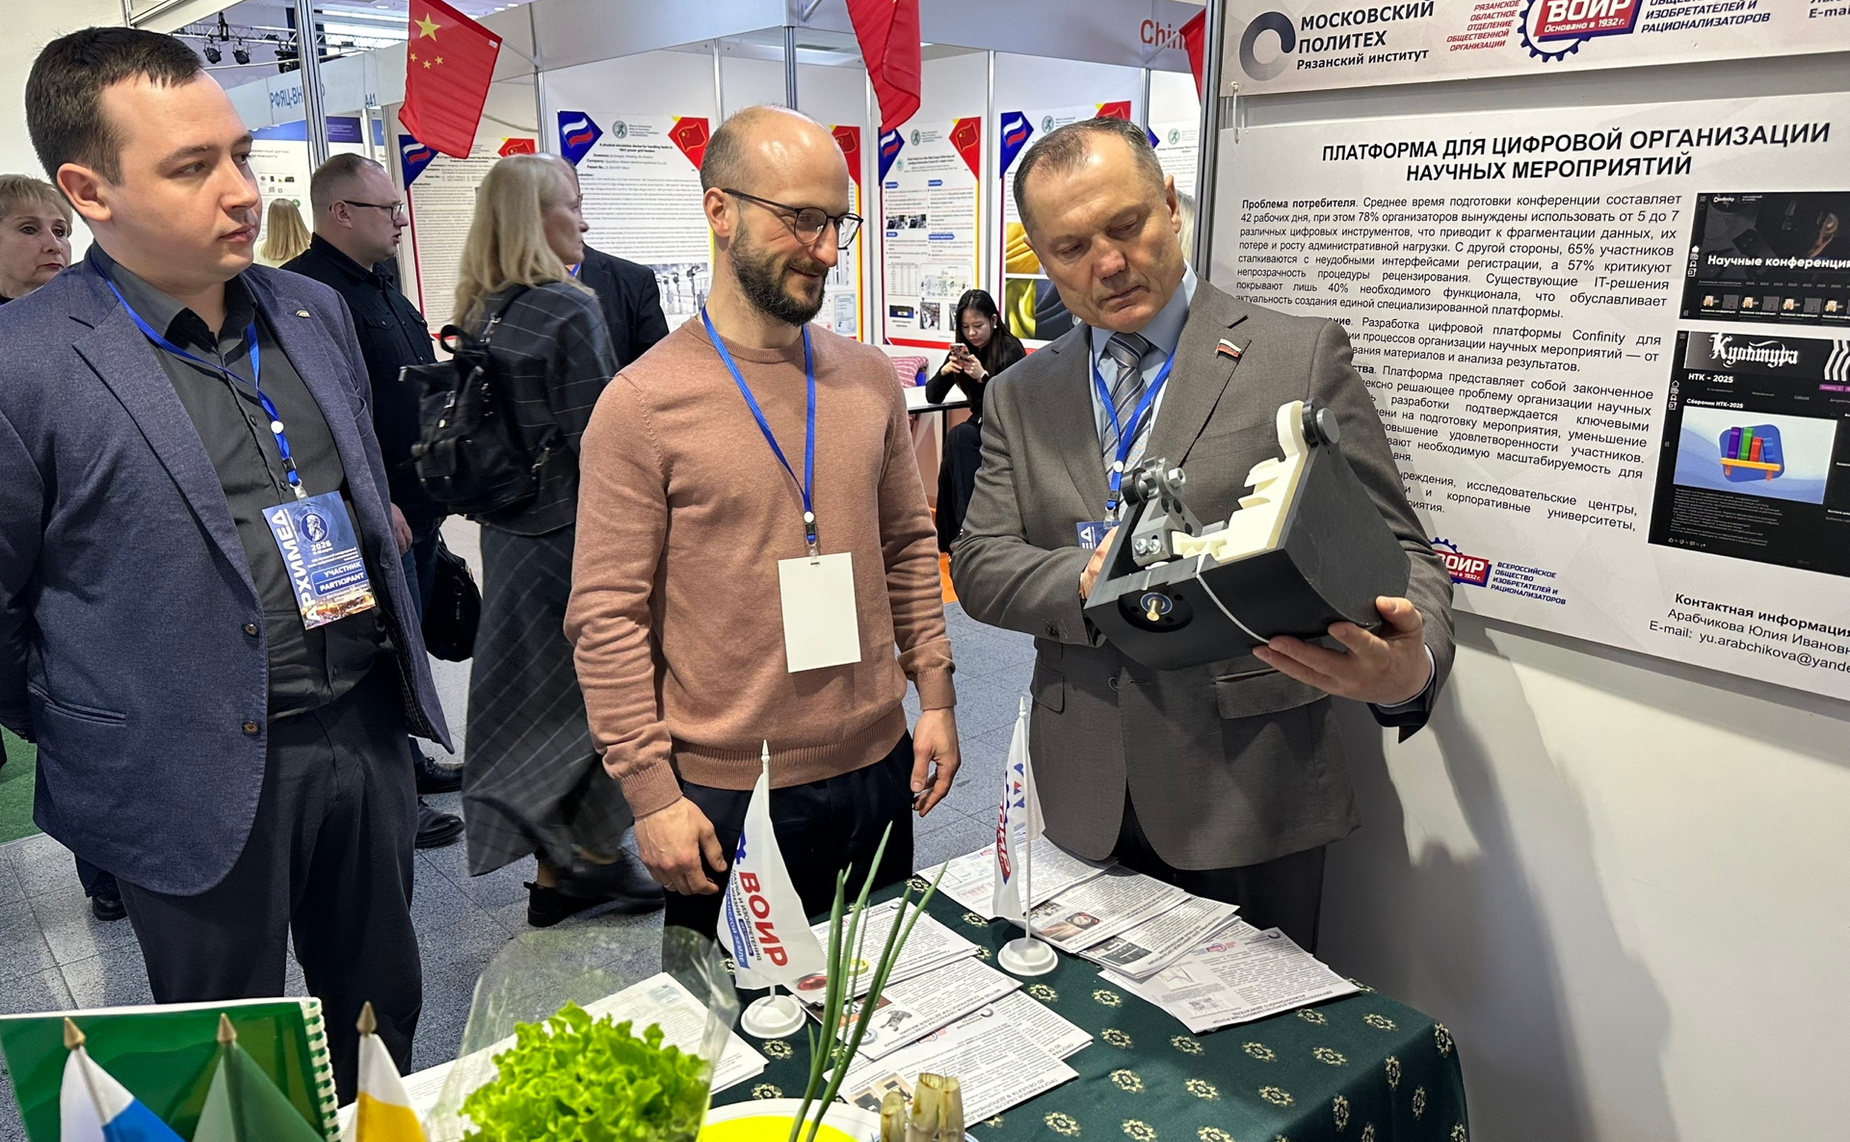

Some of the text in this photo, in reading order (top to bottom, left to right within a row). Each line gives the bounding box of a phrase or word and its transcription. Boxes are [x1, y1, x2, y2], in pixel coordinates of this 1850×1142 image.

[1301, 0, 1434, 31] МОСКОВСКИЙ
[1470, 10, 1517, 21] ОБЛАСТНОЕ
[1474, 0, 1520, 11] РЯЗАНСКОЕ
[1546, 0, 1631, 23] ВОИР
[1646, 0, 1744, 19] ИЗОБРЕТАТЕЛЕЙ
[1747, 0, 1758, 10] И
[1467, 20, 1514, 31] ОТДЕЛЕНИЕ
[1544, 22, 1587, 33] Основано
[1641, 13, 1771, 33] РАЦИОНАЛИЗАТОРОВ
[1299, 30, 1387, 54] ПОЛИТЕХ
[1447, 28, 1510, 42] ОБЩЕСТВЕННОЙ
[1450, 40, 1506, 52] ОРГАНИЗАЦИИ
[1297, 50, 1429, 70] Рязанский институт
[1322, 123, 1830, 161] ПЛАТФОРМА ДЛЯ ЦИФРОВОЙ ОРГАНИЗАЦИИ
[1407, 152, 1691, 181] НАУЧНЫХ МЕРОПРИЯТИЙ
[1242, 195, 1682, 211] Проблема потребителя. Среднее время подготовки конференции составляет
[1241, 212, 1615, 225] 42 рабочих дня, при этом 78% организаторов вынуждены использовать
[1240, 226, 1677, 240] различных цифровых инструментов, что приводит фрагментации данных, их
[1239, 241, 1674, 258] потере росту административной нагрузки. другой стороны, 65% участников
[1238, 254, 1672, 276] сталкиваются неудобными интерфейсами регистрации, 57% критикуют
[1708, 255, 1762, 267] Научные
[1238, 269, 1306, 279] непрозрачность
[1318, 271, 1370, 281] процедуры
[1382, 272, 1471, 284] рецензирования.
[1486, 273, 1578, 288] Существующие
[1236, 282, 1667, 306] покрывают лишь 40% необходимого функционала, что обуславливает
[1295, 298, 1337, 307] создания
[1340, 298, 1375, 308] единой
[1377, 301, 1489, 314] специализированной
[1492, 306, 1563, 319] платформы.
[1362, 317, 1419, 330] Разработка
[1428, 322, 1483, 334] цифровой
[1493, 326, 1561, 340] платформы
[1572, 329, 1626, 346] Confinity
[1636, 336, 1661, 346] для
[1363, 333, 1415, 344] процессов
[1418, 337, 1486, 350] организации
[1489, 342, 1537, 353] научных
[1540, 346, 1622, 359] мероприятий
[1644, 353, 1659, 362] от
[1384, 349, 1445, 361] материалов
[1458, 354, 1503, 366] анализа
[1506, 358, 1580, 372] результатов.
[1383, 365, 1443, 381] Платформа
[1449, 373, 1525, 388] представляет
[1531, 380, 1566, 392] собой
[1573, 384, 1653, 400] законченное
[1688, 373, 1734, 383] НТК 2025
[1383, 424, 1644, 463] овышение удовлетворенности участников.
[1418, 442, 1490, 459] необходимую
[1497, 452, 1611, 475] масштабируемость
[1618, 468, 1643, 479] для
[1467, 482, 1577, 505] исследовательские
[1588, 500, 1637, 517] центры,
[1447, 493, 1531, 513] корпоративные
[1547, 509, 1635, 532] университеты,
[272, 508, 321, 622] АРХИМЕД
[324, 561, 361, 577] УЧАСТНИК
[1495, 569, 1534, 581] ОБЩЕСТВО
[1497, 562, 1556, 578] ВСЕРОССИЙСКОЕ
[320, 572, 364, 592] PARTICIPANT
[1493, 577, 1551, 594] ИЗОБРЕТАТЕЛЕЙ
[1491, 585, 1566, 605] РАЦИОНАЛИЗАТОРОВ
[1675, 593, 1754, 618] Контактная
[1649, 620, 1692, 638] E-mail:
[1668, 608, 1744, 633] Арабчикова
[1748, 625, 1788, 642] Юлия
[739, 871, 788, 968] ВОИР
[740, 904, 762, 961] ИЗОБРЕТЕНИЯ
